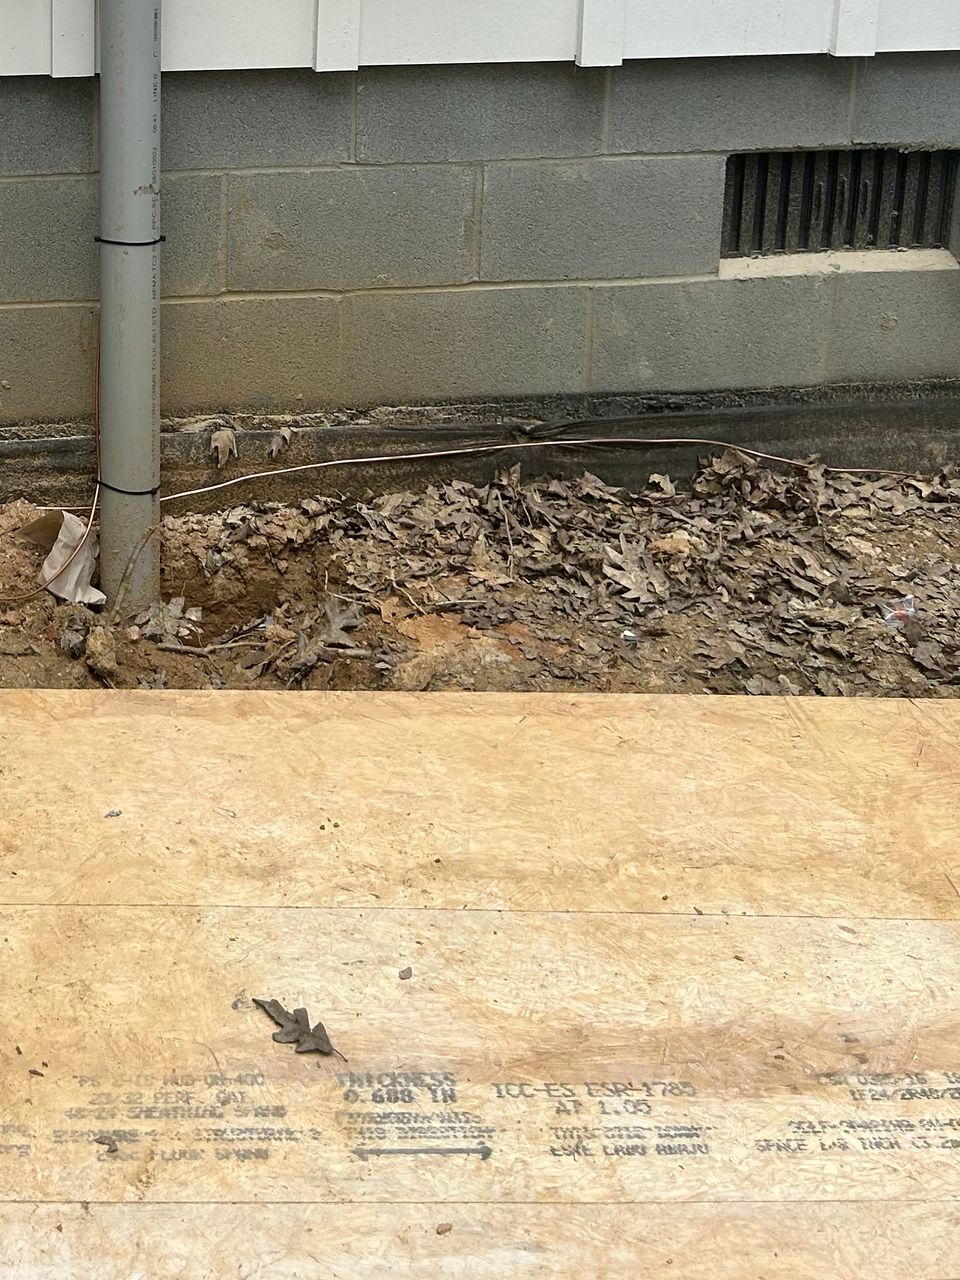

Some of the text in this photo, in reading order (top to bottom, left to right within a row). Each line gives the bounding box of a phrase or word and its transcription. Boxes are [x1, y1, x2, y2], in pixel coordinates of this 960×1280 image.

[336, 1072, 457, 1088] THICKNESS
[491, 1082, 577, 1098] ICC-ES
[754, 1138, 808, 1152] SPACE
